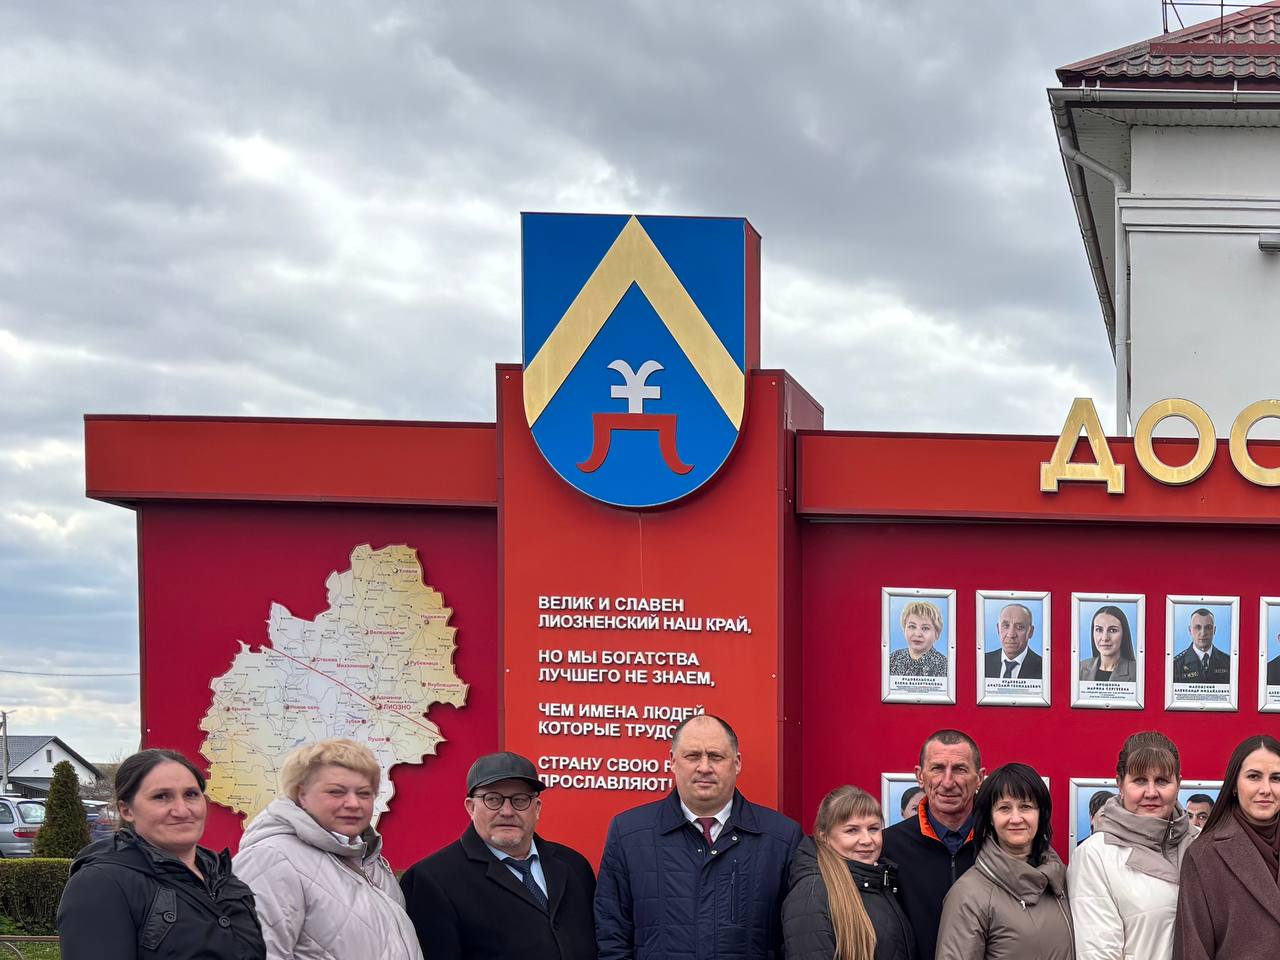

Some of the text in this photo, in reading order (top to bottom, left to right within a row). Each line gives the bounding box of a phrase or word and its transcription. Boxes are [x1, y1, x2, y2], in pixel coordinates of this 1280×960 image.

[538, 596, 685, 612] ВЕЛИК И СЛАВЕН
[538, 613, 752, 634] ЛИОЗНЕНСКИЙ НАШ КРАЙ,
[538, 649, 700, 666] НО МЫ БОГАТСТВА
[538, 668, 716, 687] ЛУЧШЕГО НЕ ЗНАЕМ,
[538, 702, 705, 723] ЧЕМ ИМЕНА ЛЮДЕЙ
[538, 721, 677, 740] КОТОРЫЕ ТРУДО
[538, 755, 603, 771] СТРАНУ
[606, 757, 660, 773] СВОЮ
